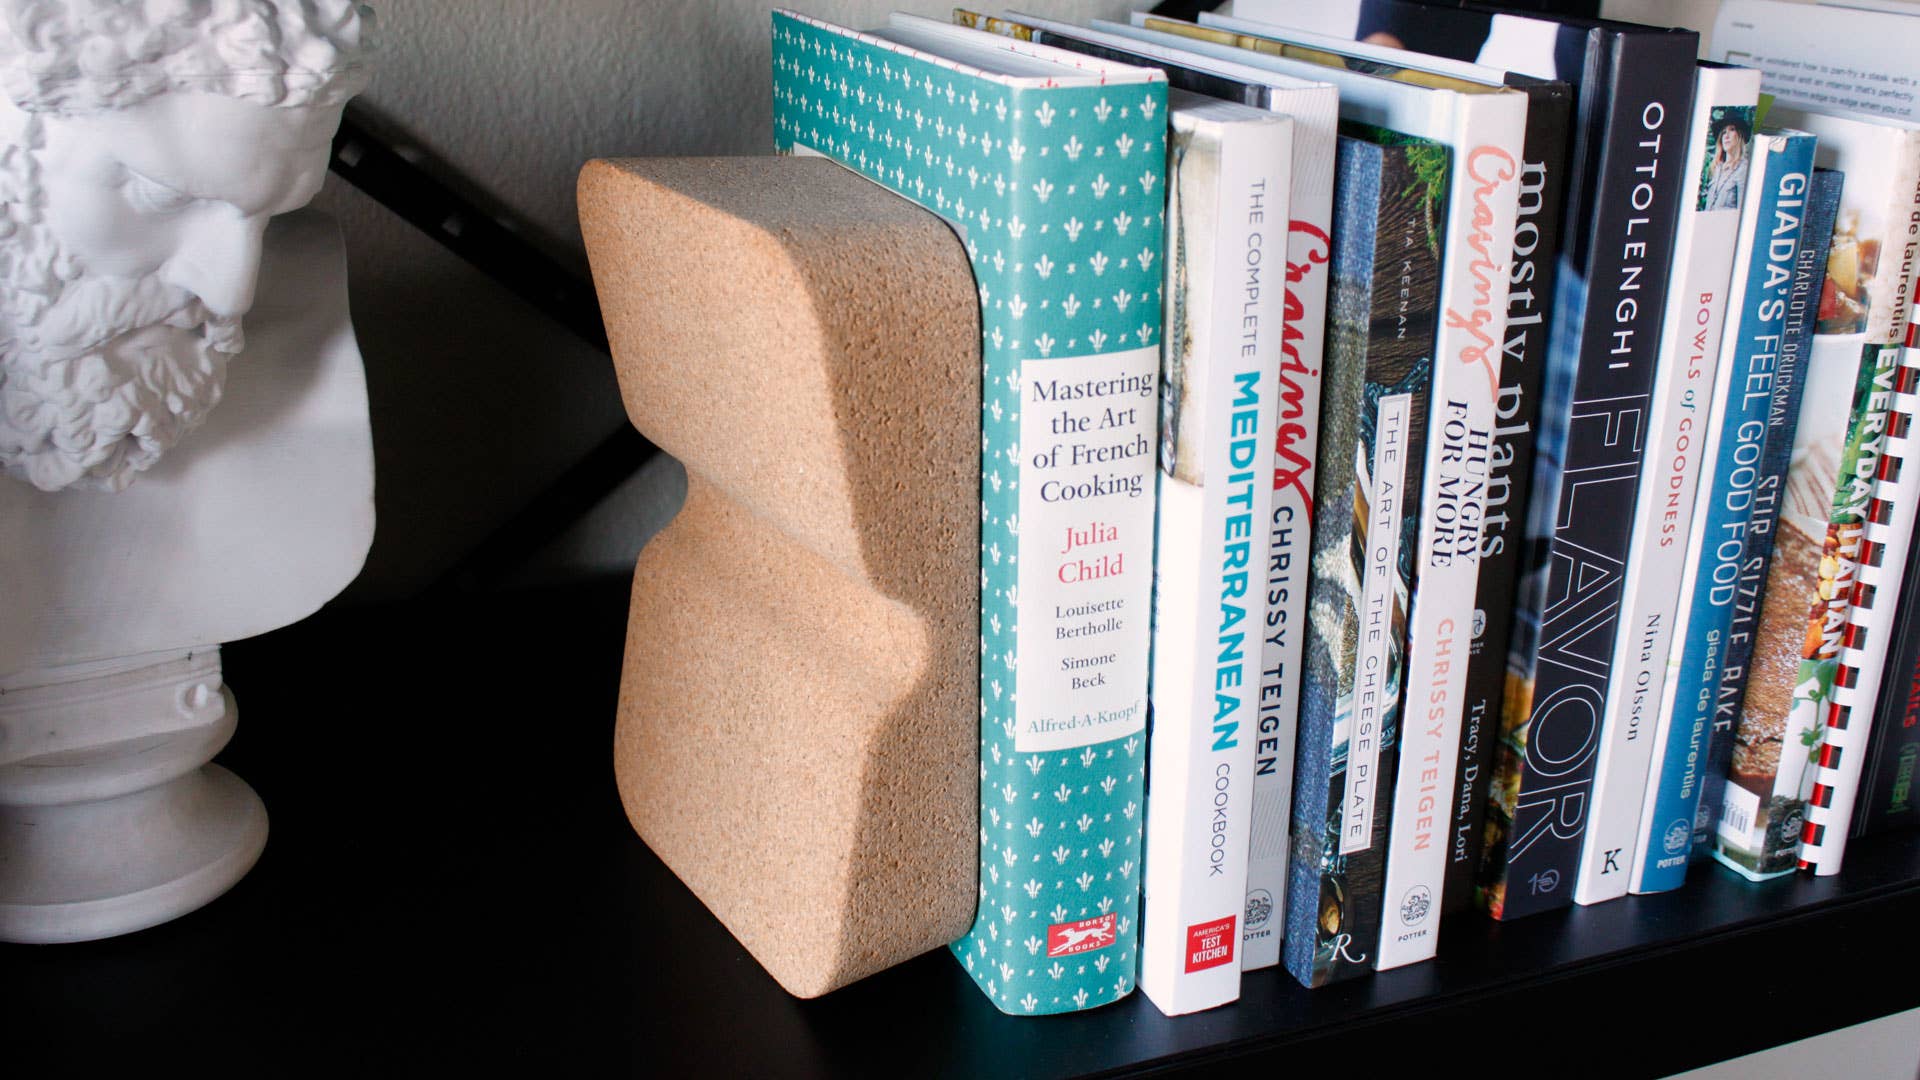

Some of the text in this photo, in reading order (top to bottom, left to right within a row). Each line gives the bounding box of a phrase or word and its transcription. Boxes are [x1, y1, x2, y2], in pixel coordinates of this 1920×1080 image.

[1879, 87, 1914, 103] perfectly
[1609, 102, 1664, 369] OTTOLENGHI
[1446, 145, 1516, 404] Cravings
[1503, 160, 1547, 363] mostly
[1397, 218, 1416, 340] TIA KEENAN
[1768, 249, 1815, 427] CHARLOTTE DRUCKMAN
[1032, 371, 1153, 402] Mastering
[1709, 173, 1807, 607] GIADA'S FEEL GOOD FOOD
[1051, 406, 1137, 435] the Art
[1660, 292, 1713, 548] BOWLS of GOODNESS
[1032, 433, 1150, 469] of French
[1040, 472, 1144, 503] Cooking
[1431, 400, 1468, 568] FOR MORE
[1457, 428, 1489, 565] HUNGRY
[1749, 474, 1780, 535] STIR
[1818, 348, 1898, 655] EVERYDAY ITALIAN
[1061, 521, 1119, 555] Julia
[1209, 178, 1265, 878] THE COMPLETE MEDITERRANEAN COOKBOOK
[1057, 552, 1124, 584] Child
[1055, 597, 1125, 619] Louisette
[1350, 410, 1399, 838] THE ART OF THE CHEESE PLATE
[1055, 617, 1124, 640] Bertholle
[1256, 506, 1294, 777] CHRISSY TEIGEN
[1507, 393, 1651, 864] FLAVOR
[1060, 651, 1117, 671] Simone
[1626, 613, 1661, 742] Nina Olsson
[1071, 672, 1106, 690] Beck
[1695, 687, 1709, 713] de
[1413, 618, 1455, 851] CHRISSY TEIGEN
[1454, 699, 1486, 863] Tracy, Dana, Lori
[1600, 848, 1623, 875] K
[1656, 855, 1687, 870] POTTER
[1068, 941, 1102, 953] BOOKS
[1192, 922, 1231, 938] AMERICA'S
[1200, 935, 1222, 951] TEST
[1243, 930, 1271, 942] OTTER
[1397, 929, 1428, 943] POTTER
[1191, 945, 1229, 965] KITCHEN
[1330, 934, 1366, 963] R
